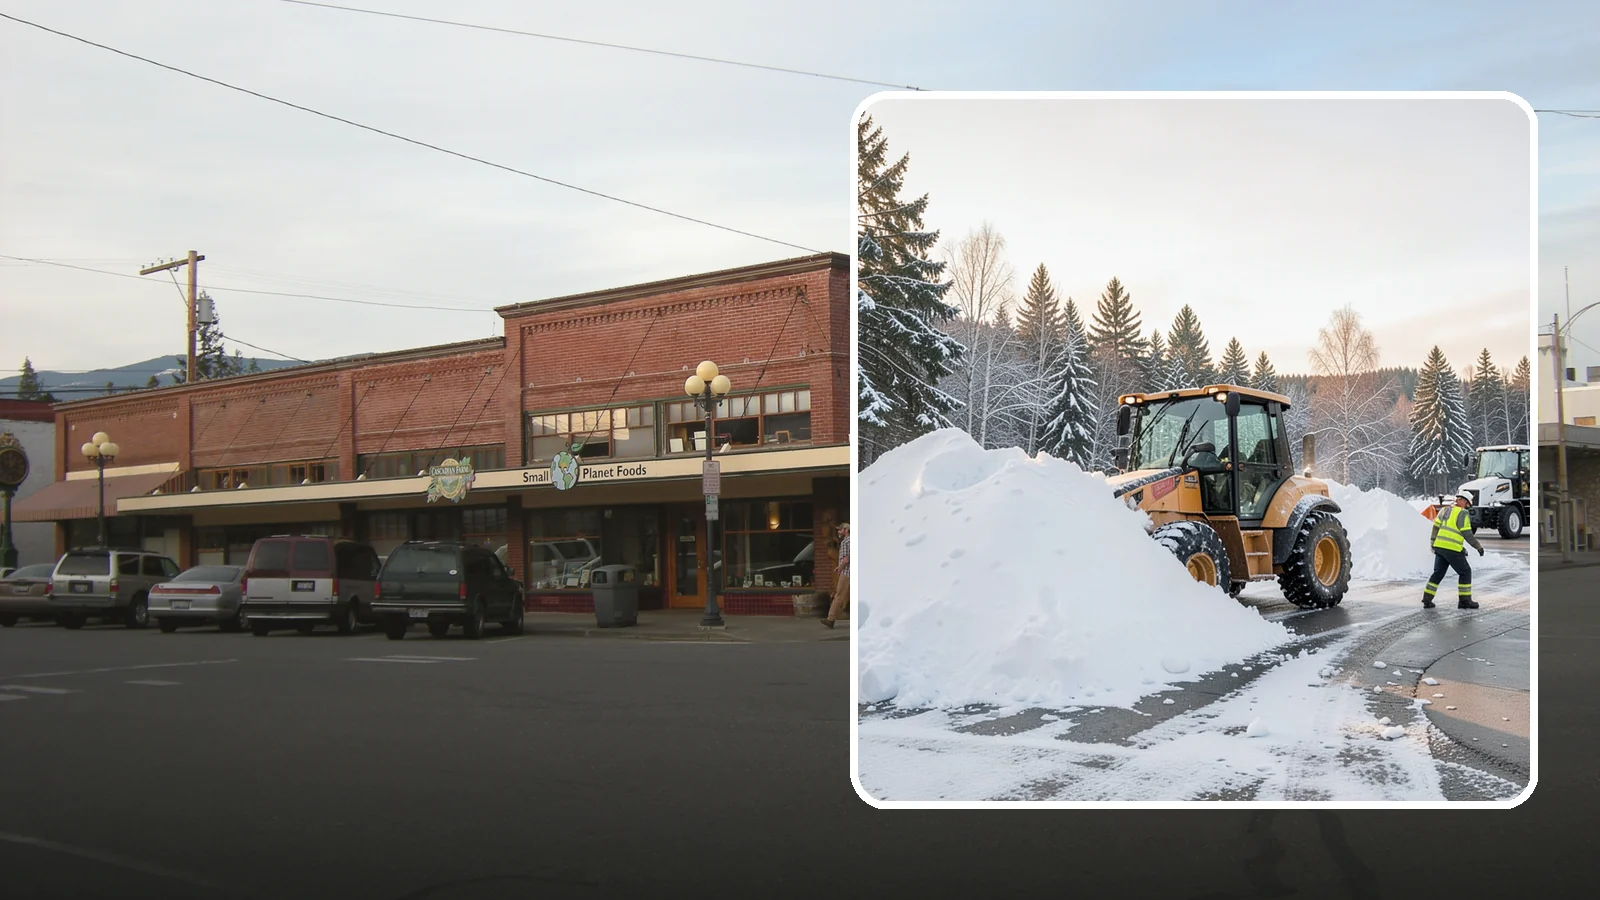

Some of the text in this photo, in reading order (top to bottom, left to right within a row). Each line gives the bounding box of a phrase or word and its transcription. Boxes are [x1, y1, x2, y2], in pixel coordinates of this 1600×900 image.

[523, 464, 647, 483] Small Planet Foods
